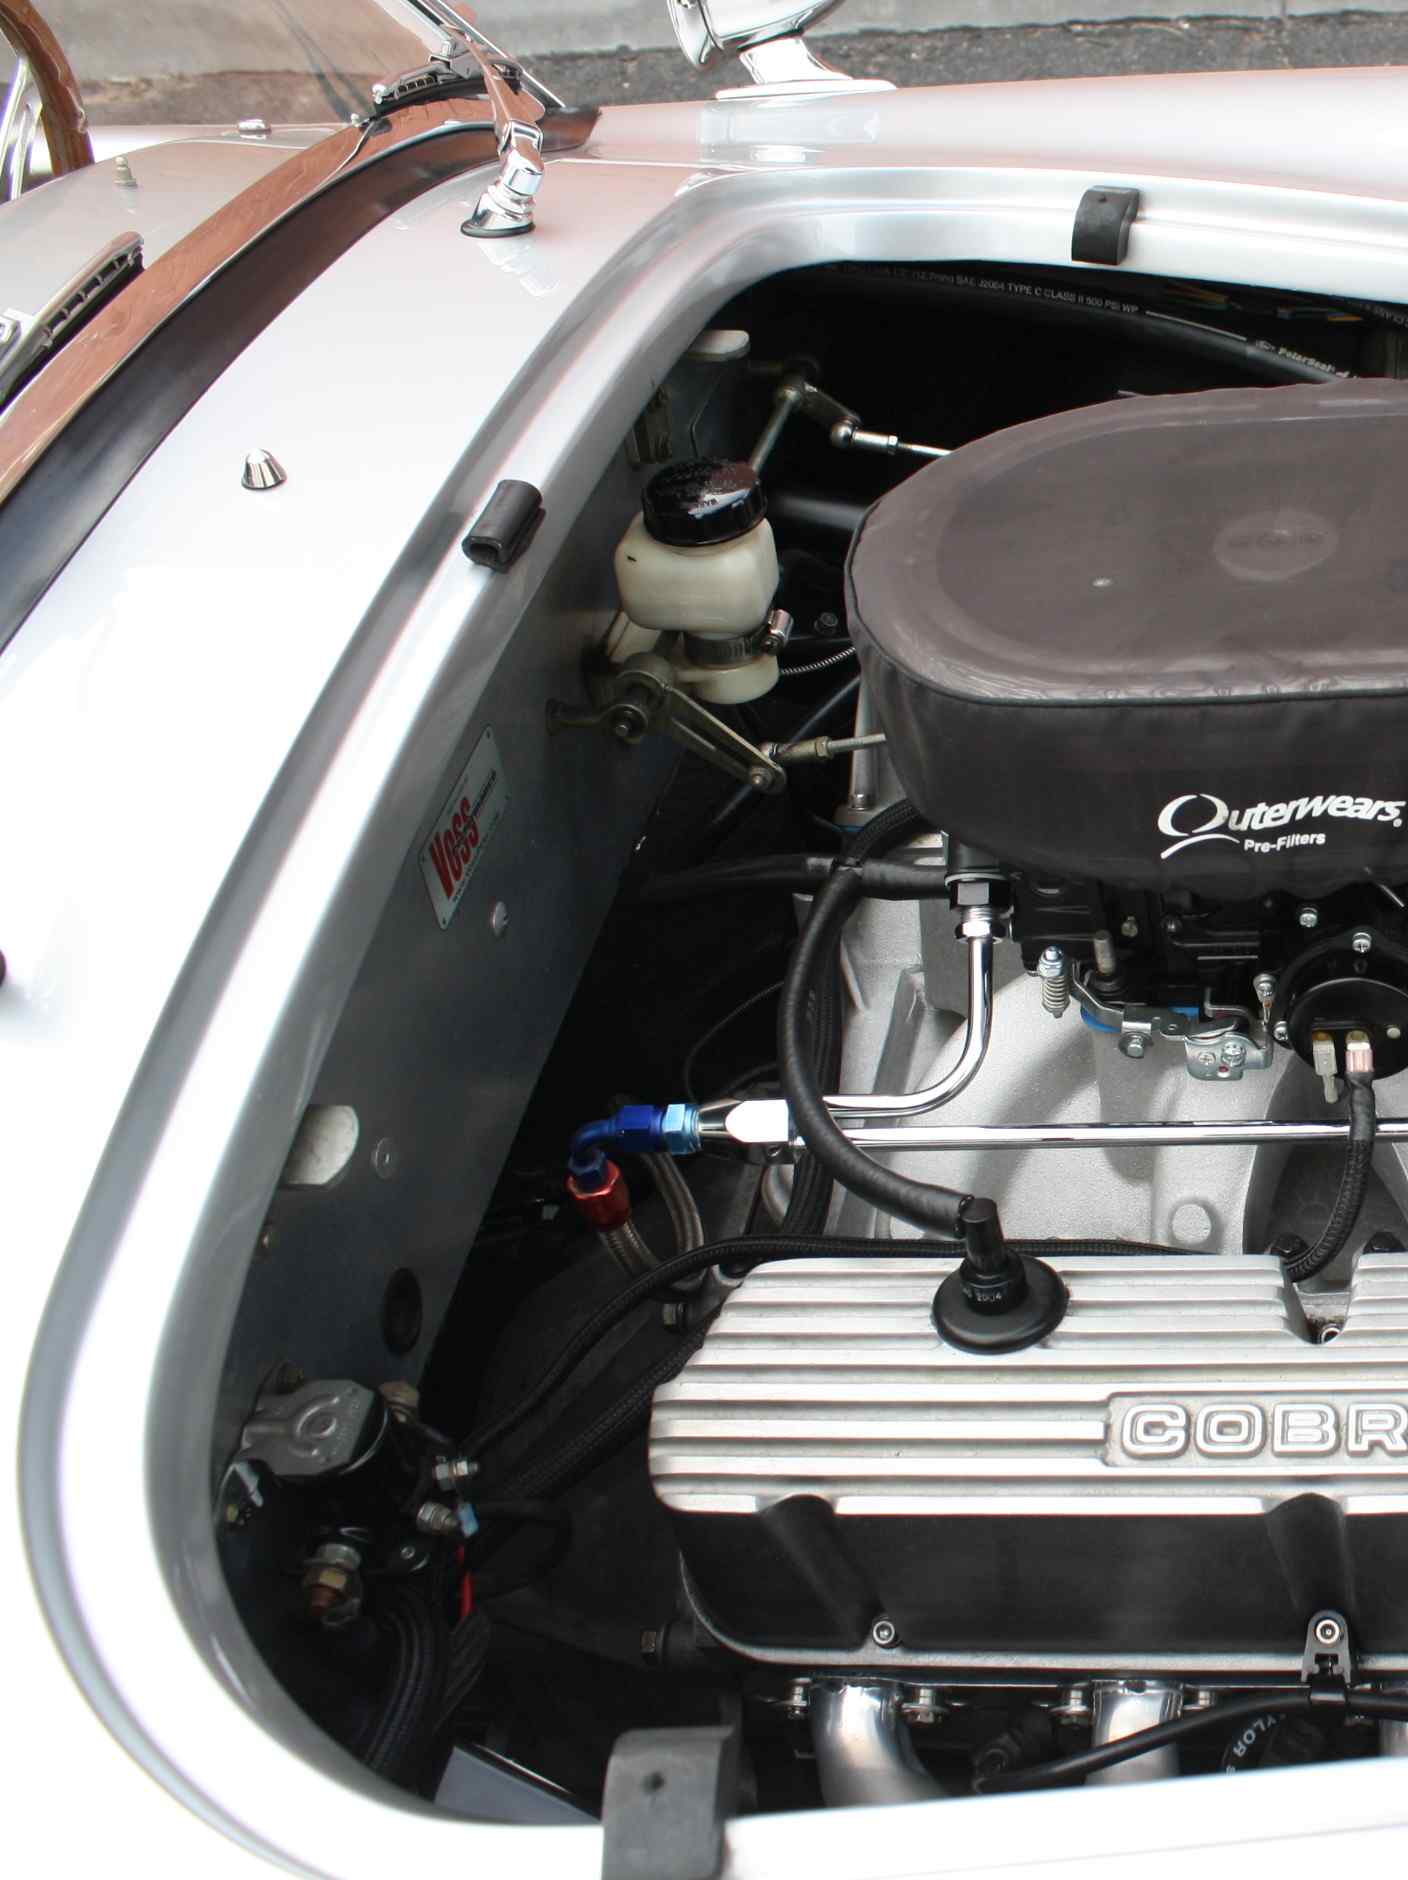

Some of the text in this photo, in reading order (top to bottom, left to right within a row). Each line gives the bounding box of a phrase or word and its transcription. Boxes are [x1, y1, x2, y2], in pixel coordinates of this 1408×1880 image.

[1007, 281, 1033, 297] TYPE
[1044, 287, 1077, 304] CLASS
[1243, 831, 1326, 853] Pre-Filters
